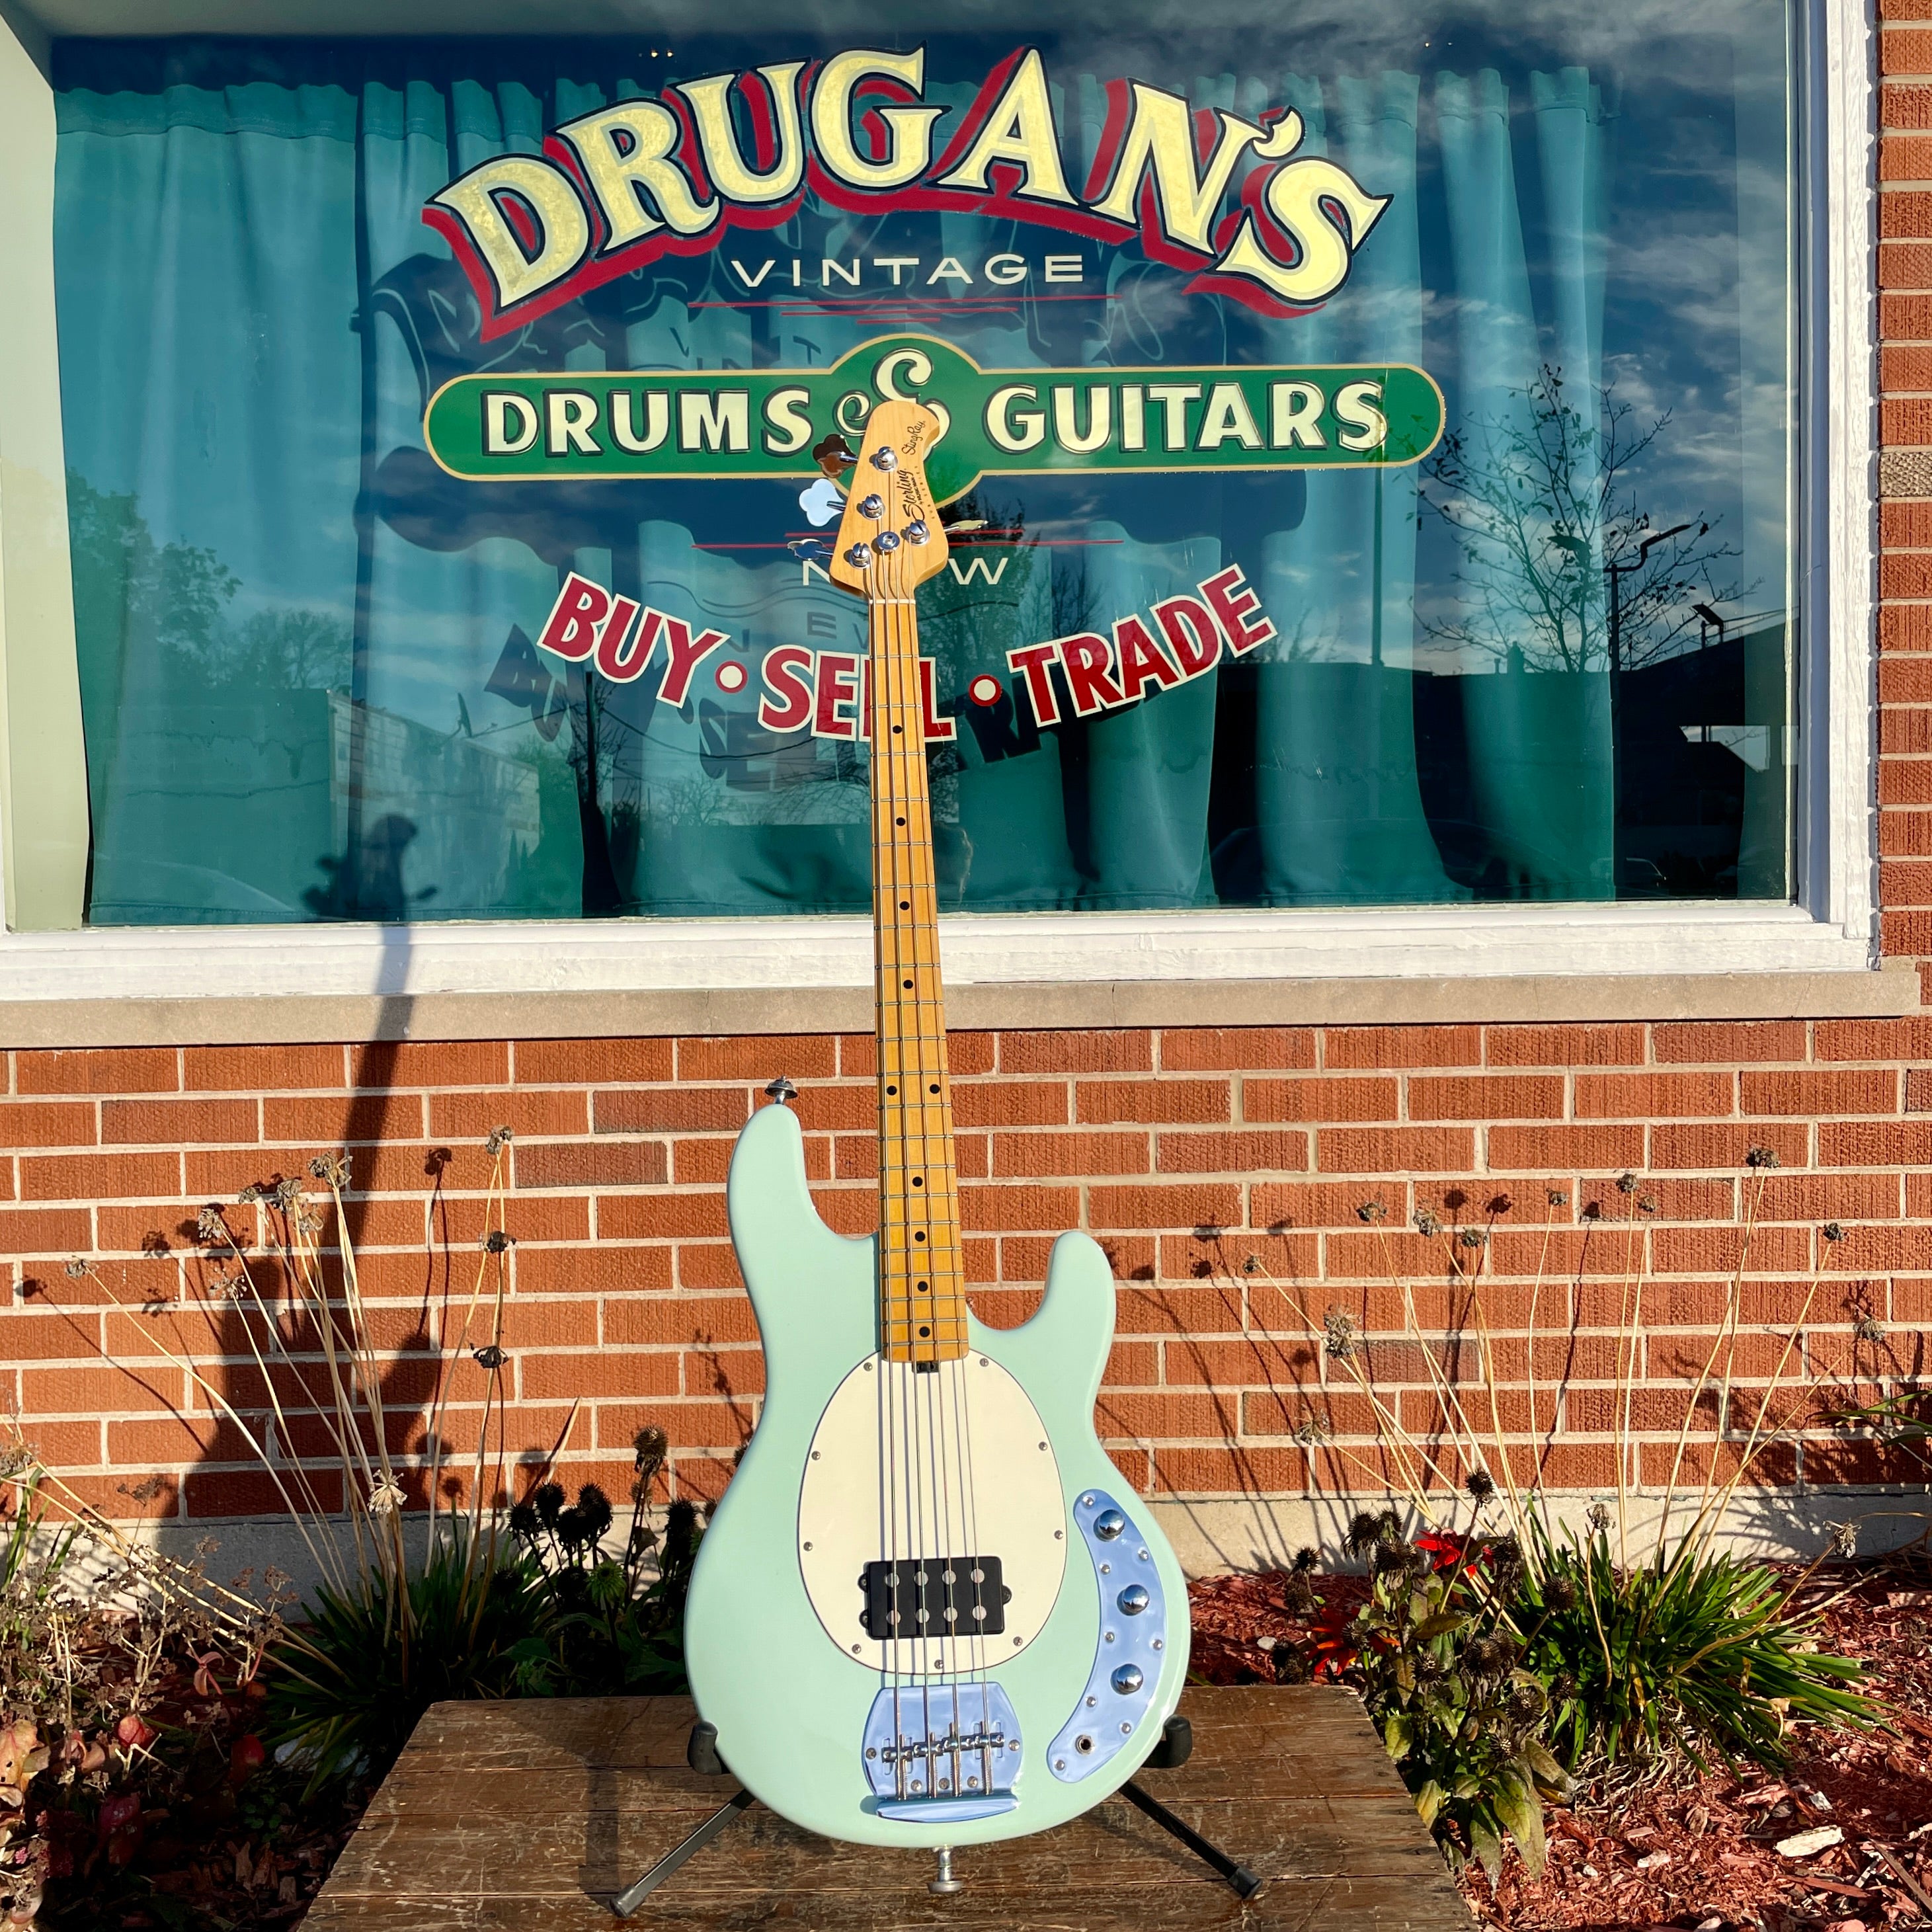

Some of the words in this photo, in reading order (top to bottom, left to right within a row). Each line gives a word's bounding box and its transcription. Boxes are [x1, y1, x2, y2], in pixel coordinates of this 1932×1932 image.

[423, 45, 1393, 319] DRUGAN'S
[731, 254, 1083, 287] VINTAGE
[483, 387, 813, 457] DRUMS
[984, 381, 1388, 454] GUITARS
[901, 421, 926, 455] StingRay
[897, 469, 925, 521] Sterling
[803, 557, 1009, 586] NW
[537, 571, 730, 709] BUY
[1006, 563, 1277, 727] TRADE
